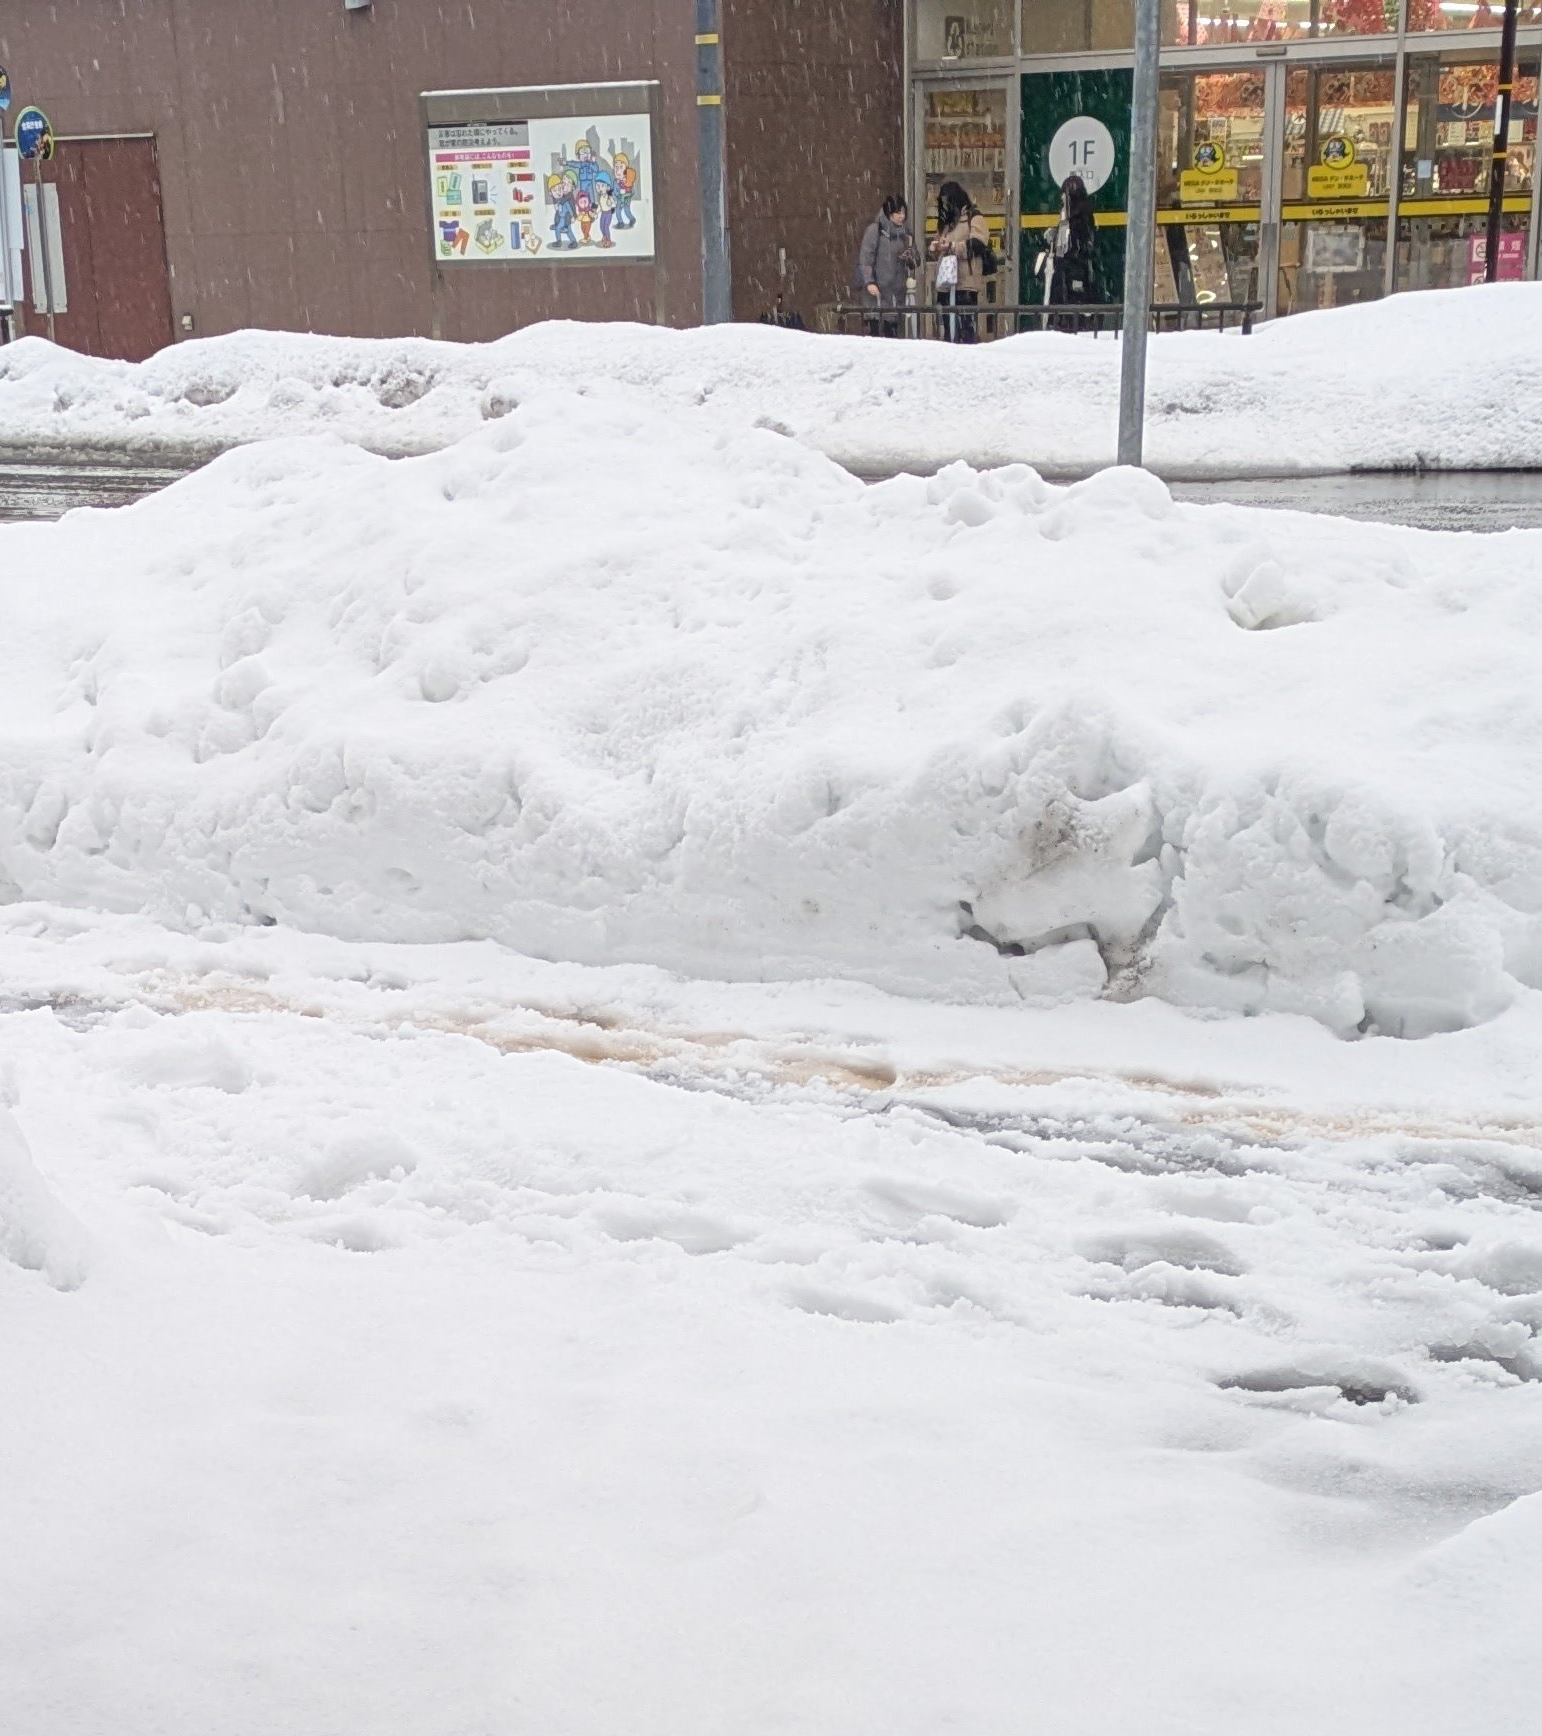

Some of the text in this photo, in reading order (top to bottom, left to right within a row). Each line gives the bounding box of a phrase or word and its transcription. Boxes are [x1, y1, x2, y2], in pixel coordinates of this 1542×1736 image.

[1068, 140, 1096, 166] 1F
[1311, 207, 1359, 215] いらっしゃいませ
[1185, 212, 1231, 220] いらっしゃいませ
